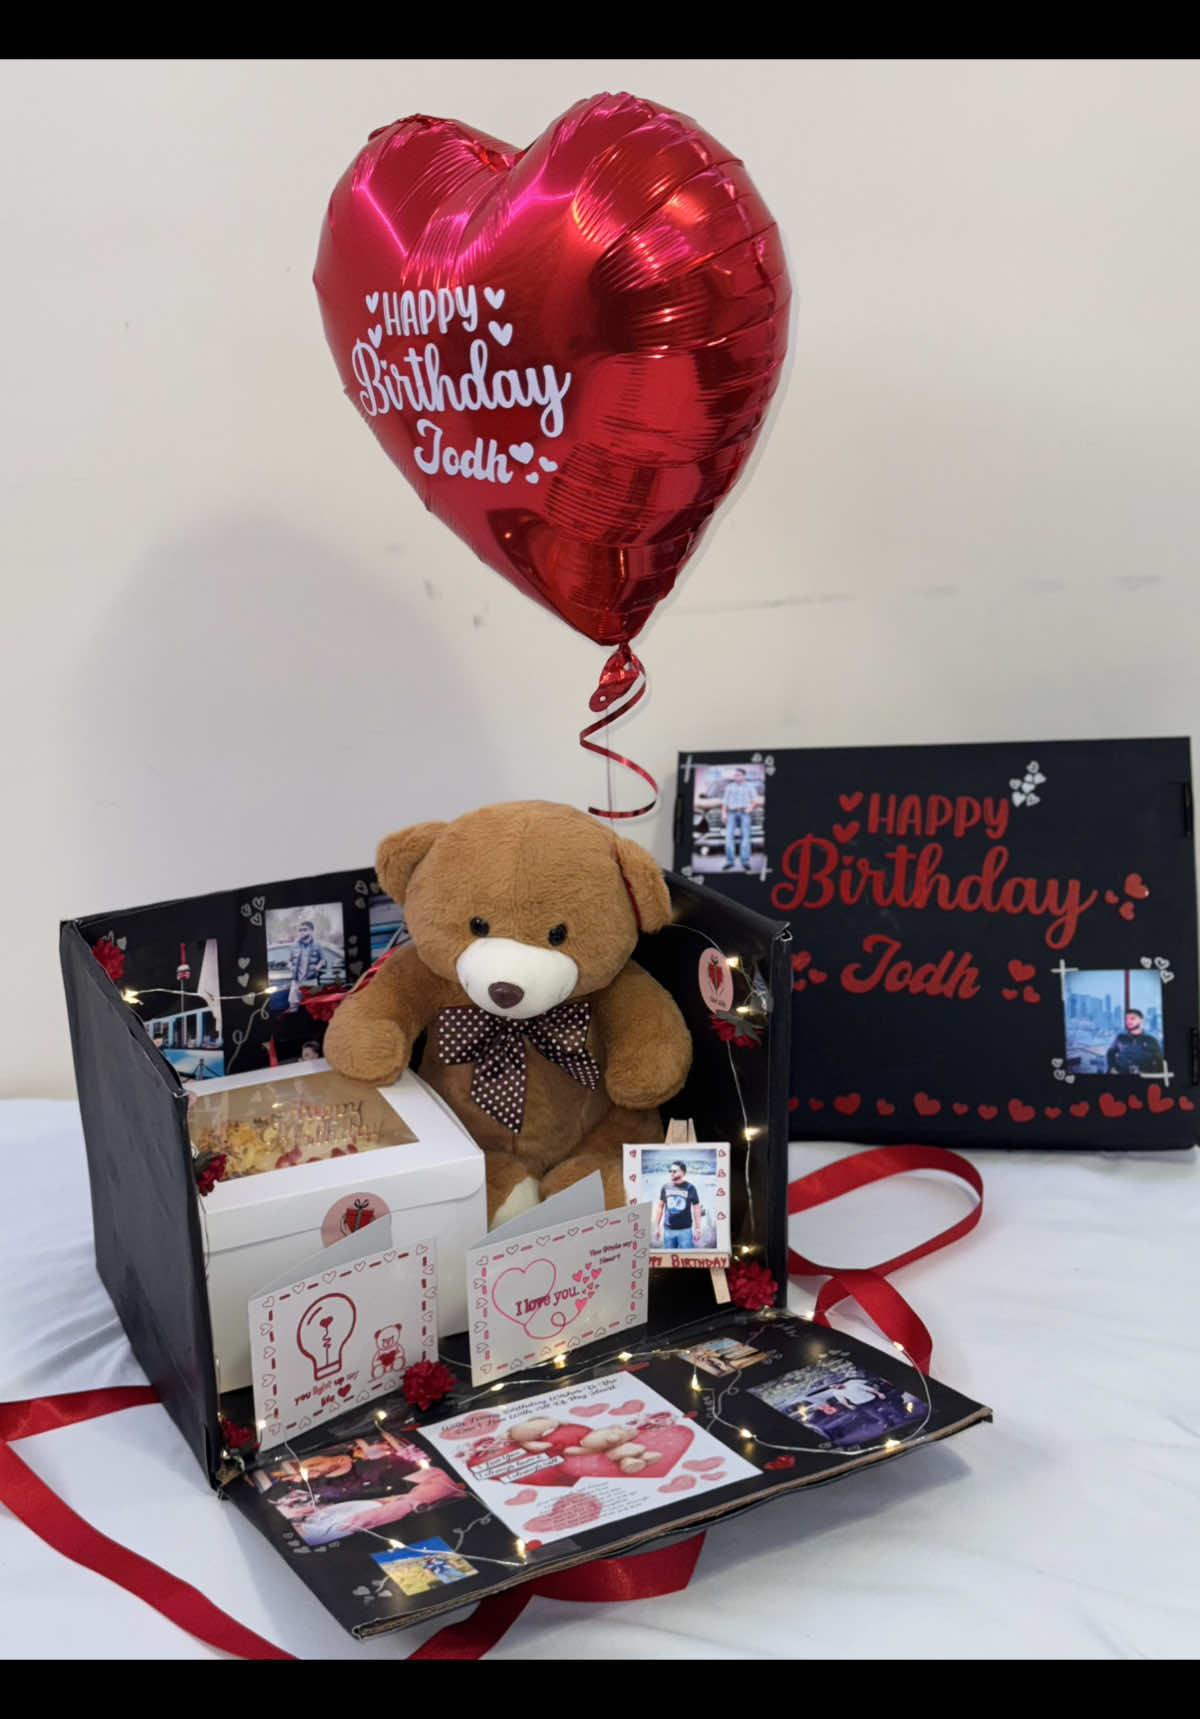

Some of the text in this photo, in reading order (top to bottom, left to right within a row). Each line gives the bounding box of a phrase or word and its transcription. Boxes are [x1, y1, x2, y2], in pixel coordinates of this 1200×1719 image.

[382, 285, 478, 336] HAPPY
[352, 338, 571, 438] Birthday
[414, 419, 513, 484] Jodh
[867, 793, 1010, 840] HAPPY
[771, 833, 1098, 950] Birthday
[840, 934, 981, 999] Jodh
[524, 1295, 551, 1313] love
